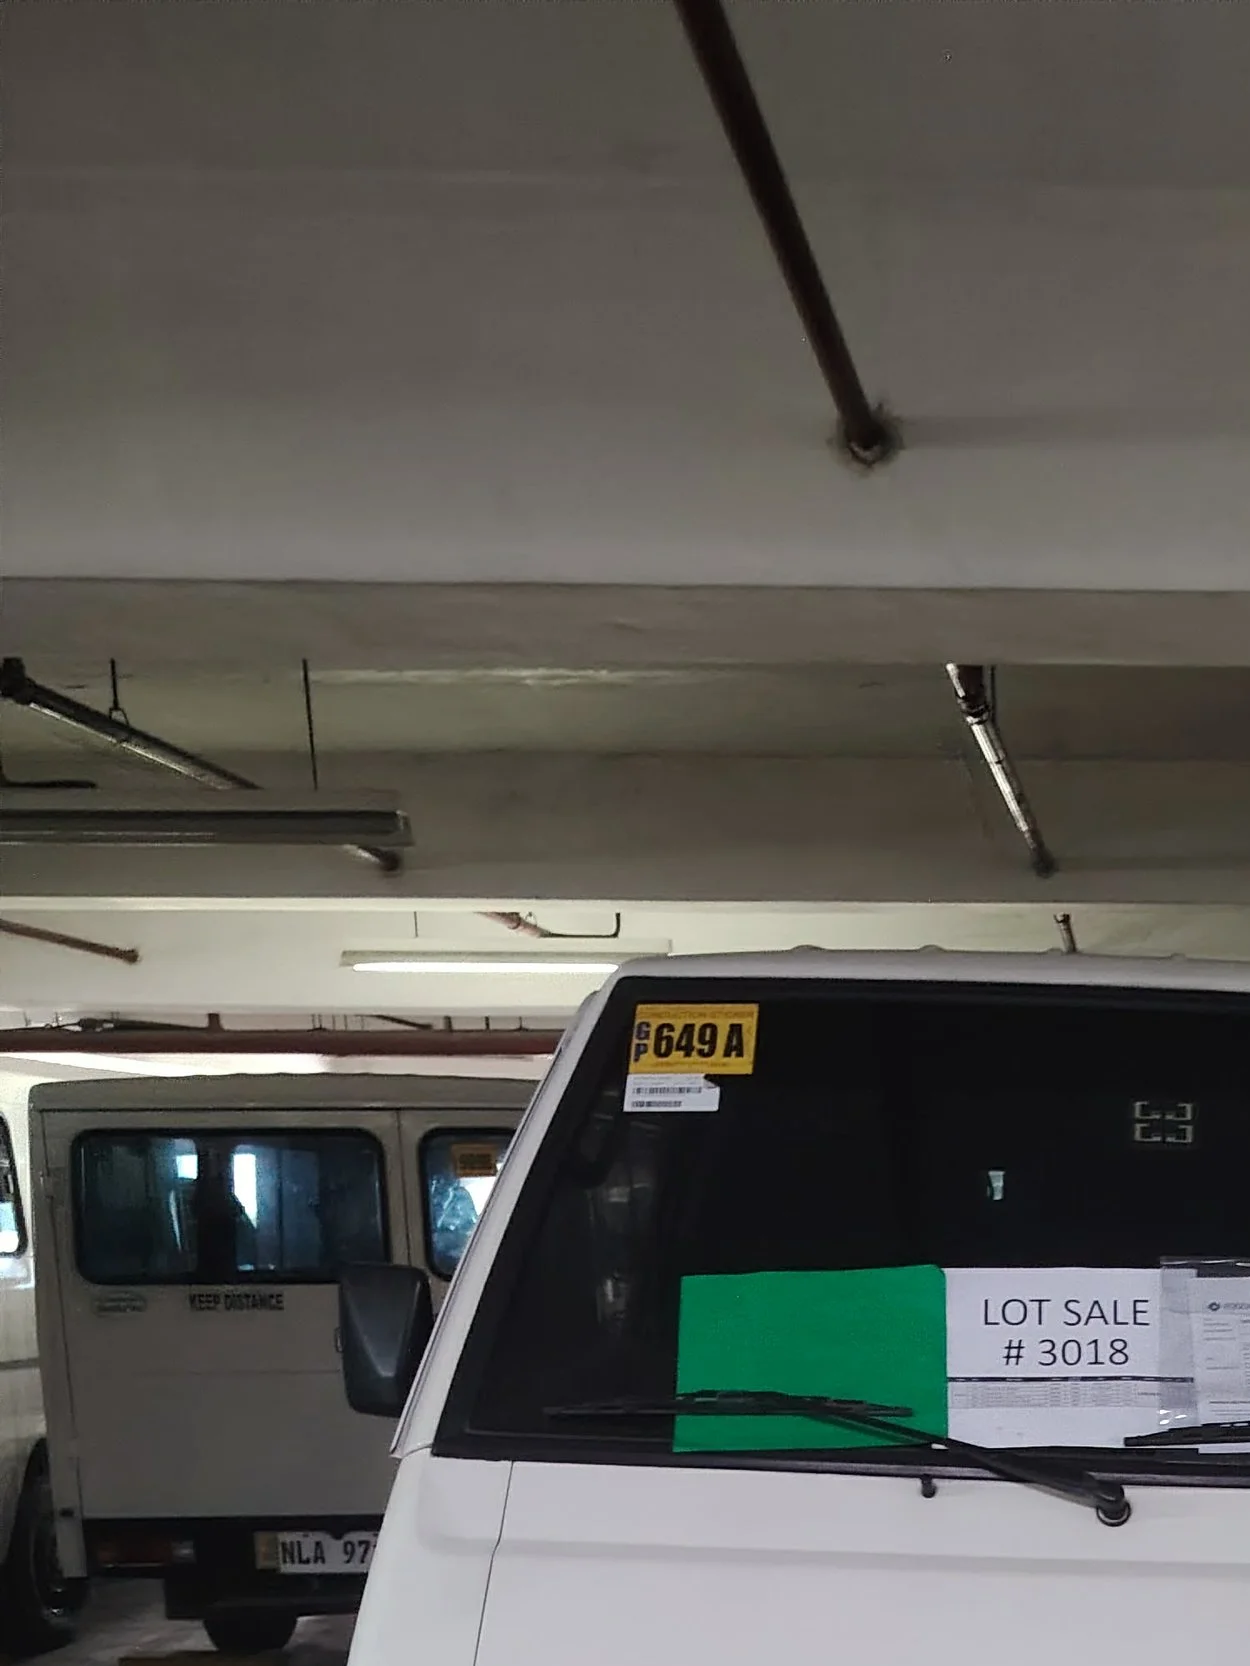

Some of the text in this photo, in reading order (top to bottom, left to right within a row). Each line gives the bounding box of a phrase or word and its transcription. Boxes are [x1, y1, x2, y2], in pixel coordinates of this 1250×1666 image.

[653, 1022, 718, 1058] 649
[722, 1023, 744, 1058] A
[983, 1298, 1150, 1326] LOT SALE
[1002, 1338, 1130, 1366] # 3018
[281, 1540, 326, 1565] NLA
